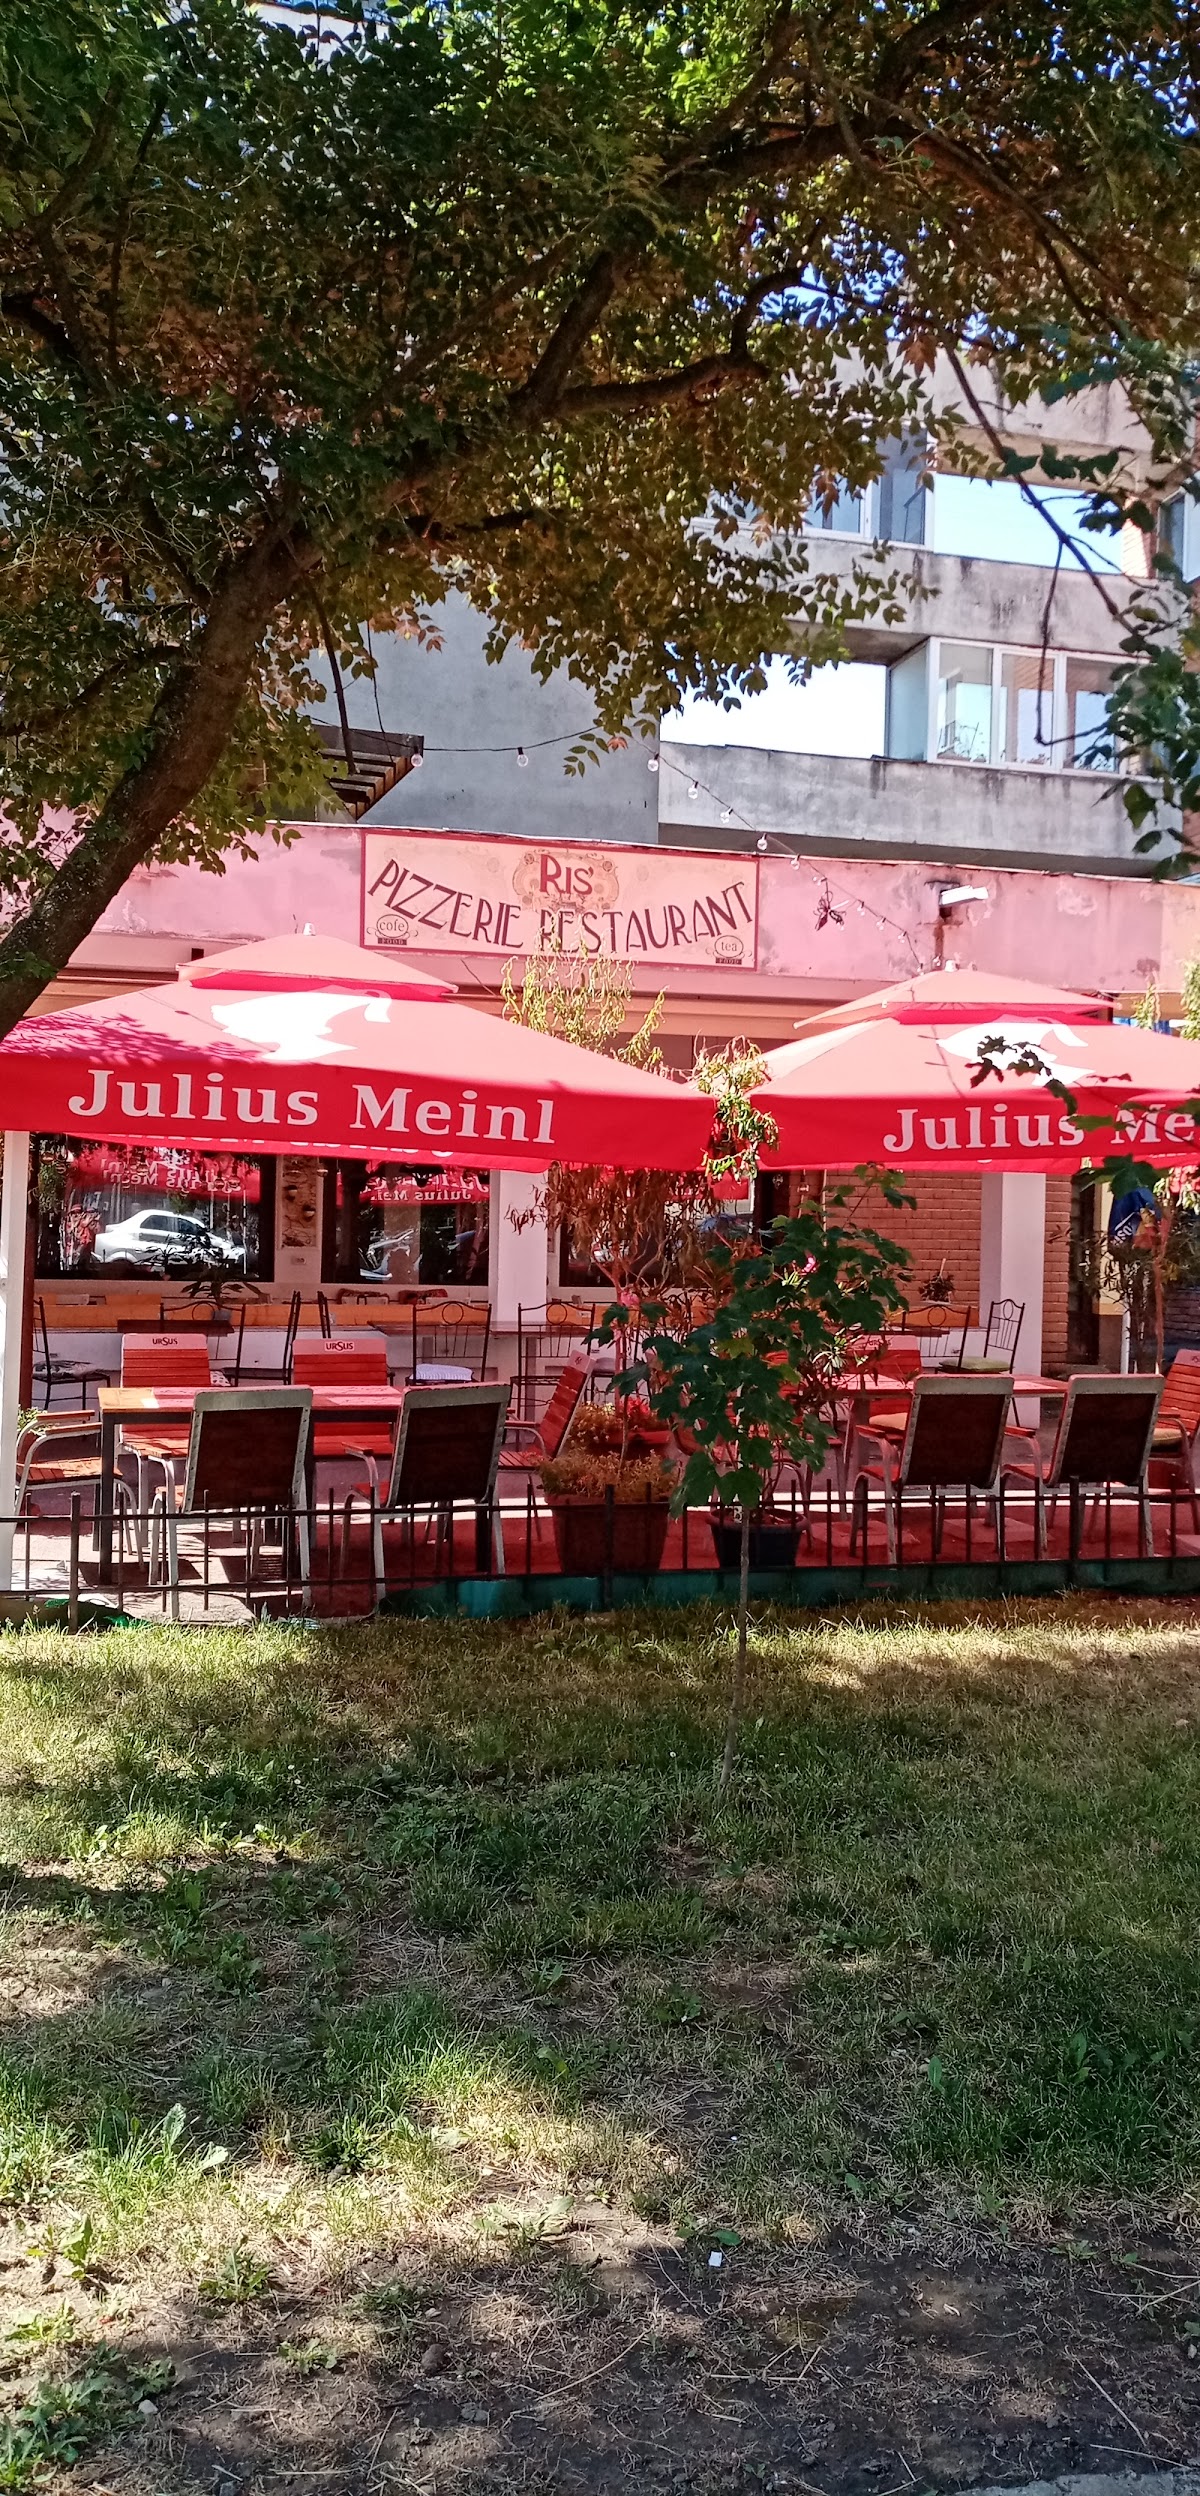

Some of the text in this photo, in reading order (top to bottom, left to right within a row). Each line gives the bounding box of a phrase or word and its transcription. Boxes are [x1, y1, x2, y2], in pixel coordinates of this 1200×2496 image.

[367, 858, 753, 953] PIZZERIE RESTAURANT
[721, 941, 738, 952] tea
[68, 1069, 556, 1144] Julius Meinl
[883, 1103, 1085, 1153] Julius
[152, 1336, 178, 1346] URSUS
[325, 1341, 354, 1351] URSUS
